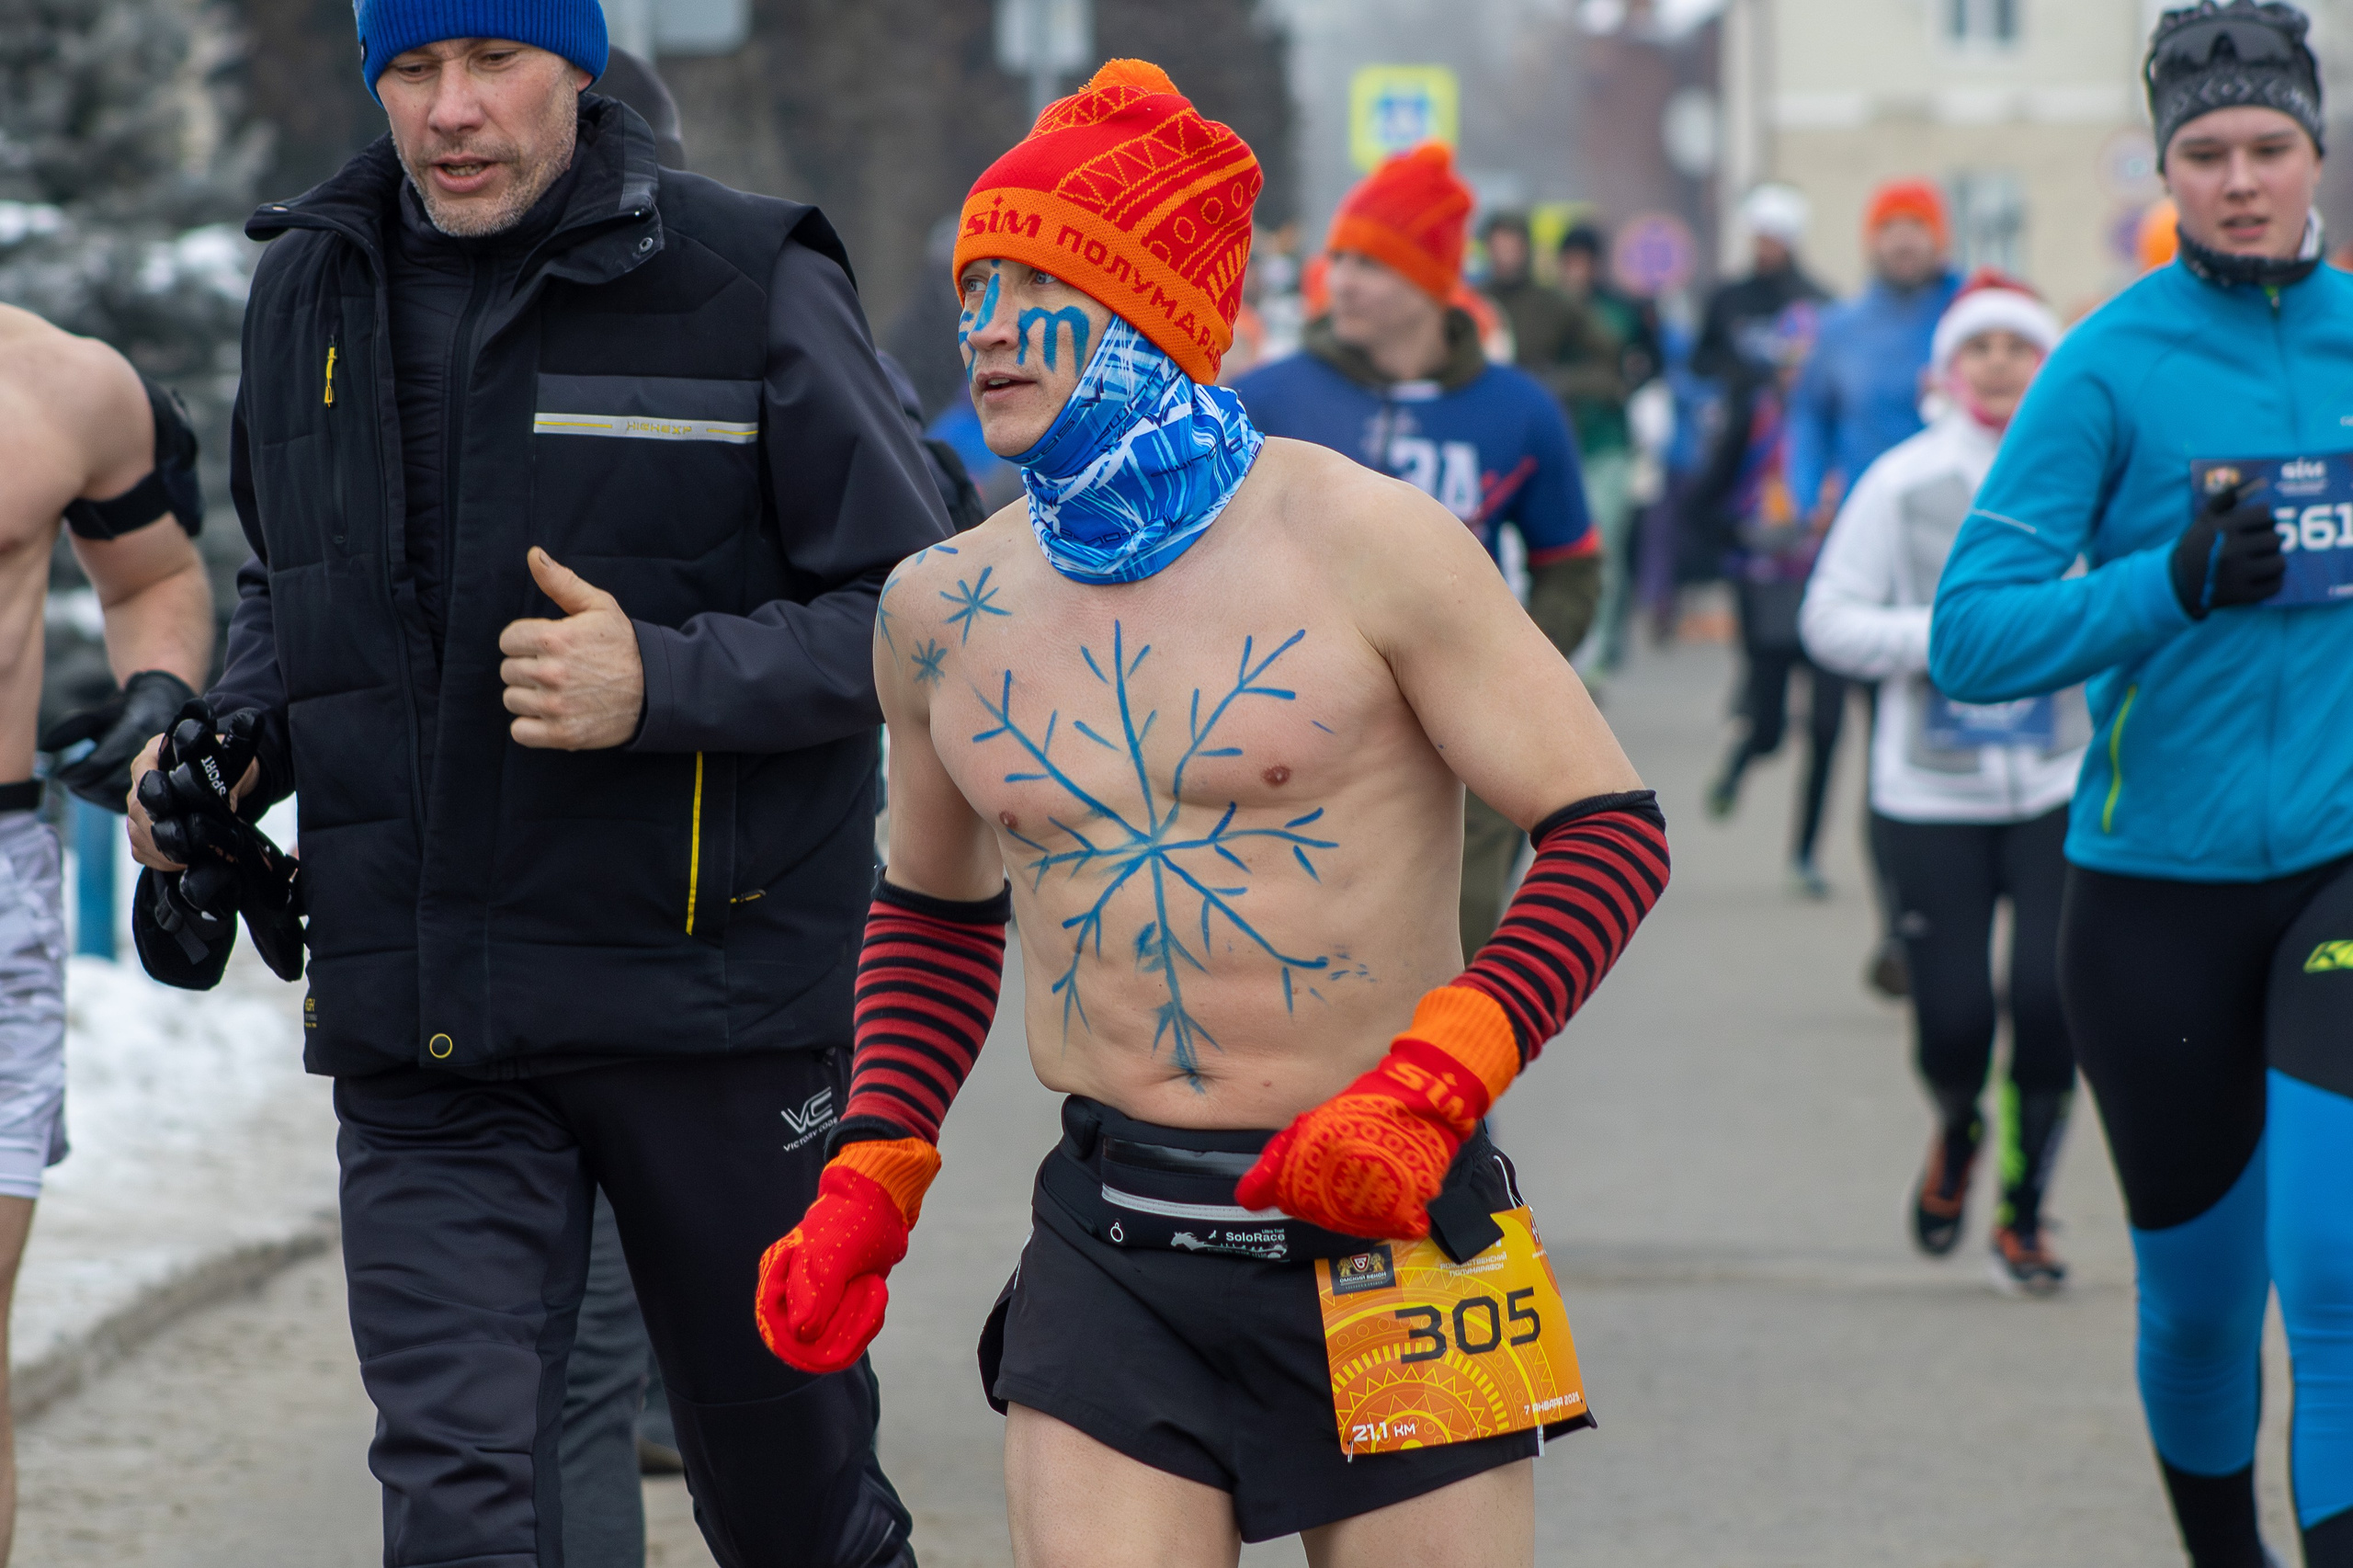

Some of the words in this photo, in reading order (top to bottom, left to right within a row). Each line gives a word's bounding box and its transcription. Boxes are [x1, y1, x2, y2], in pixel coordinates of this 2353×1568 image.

[200, 755, 227, 798] SPORT
[780, 1085, 834, 1134] VC
[783, 1129, 818, 1152] VICTORY
[1225, 1232, 1286, 1242] SoloRace
[1449, 1263, 1504, 1278] ПОЛУМАРАФОН
[1394, 1286, 1541, 1365] 305
[1523, 1404, 1530, 1415] 7
